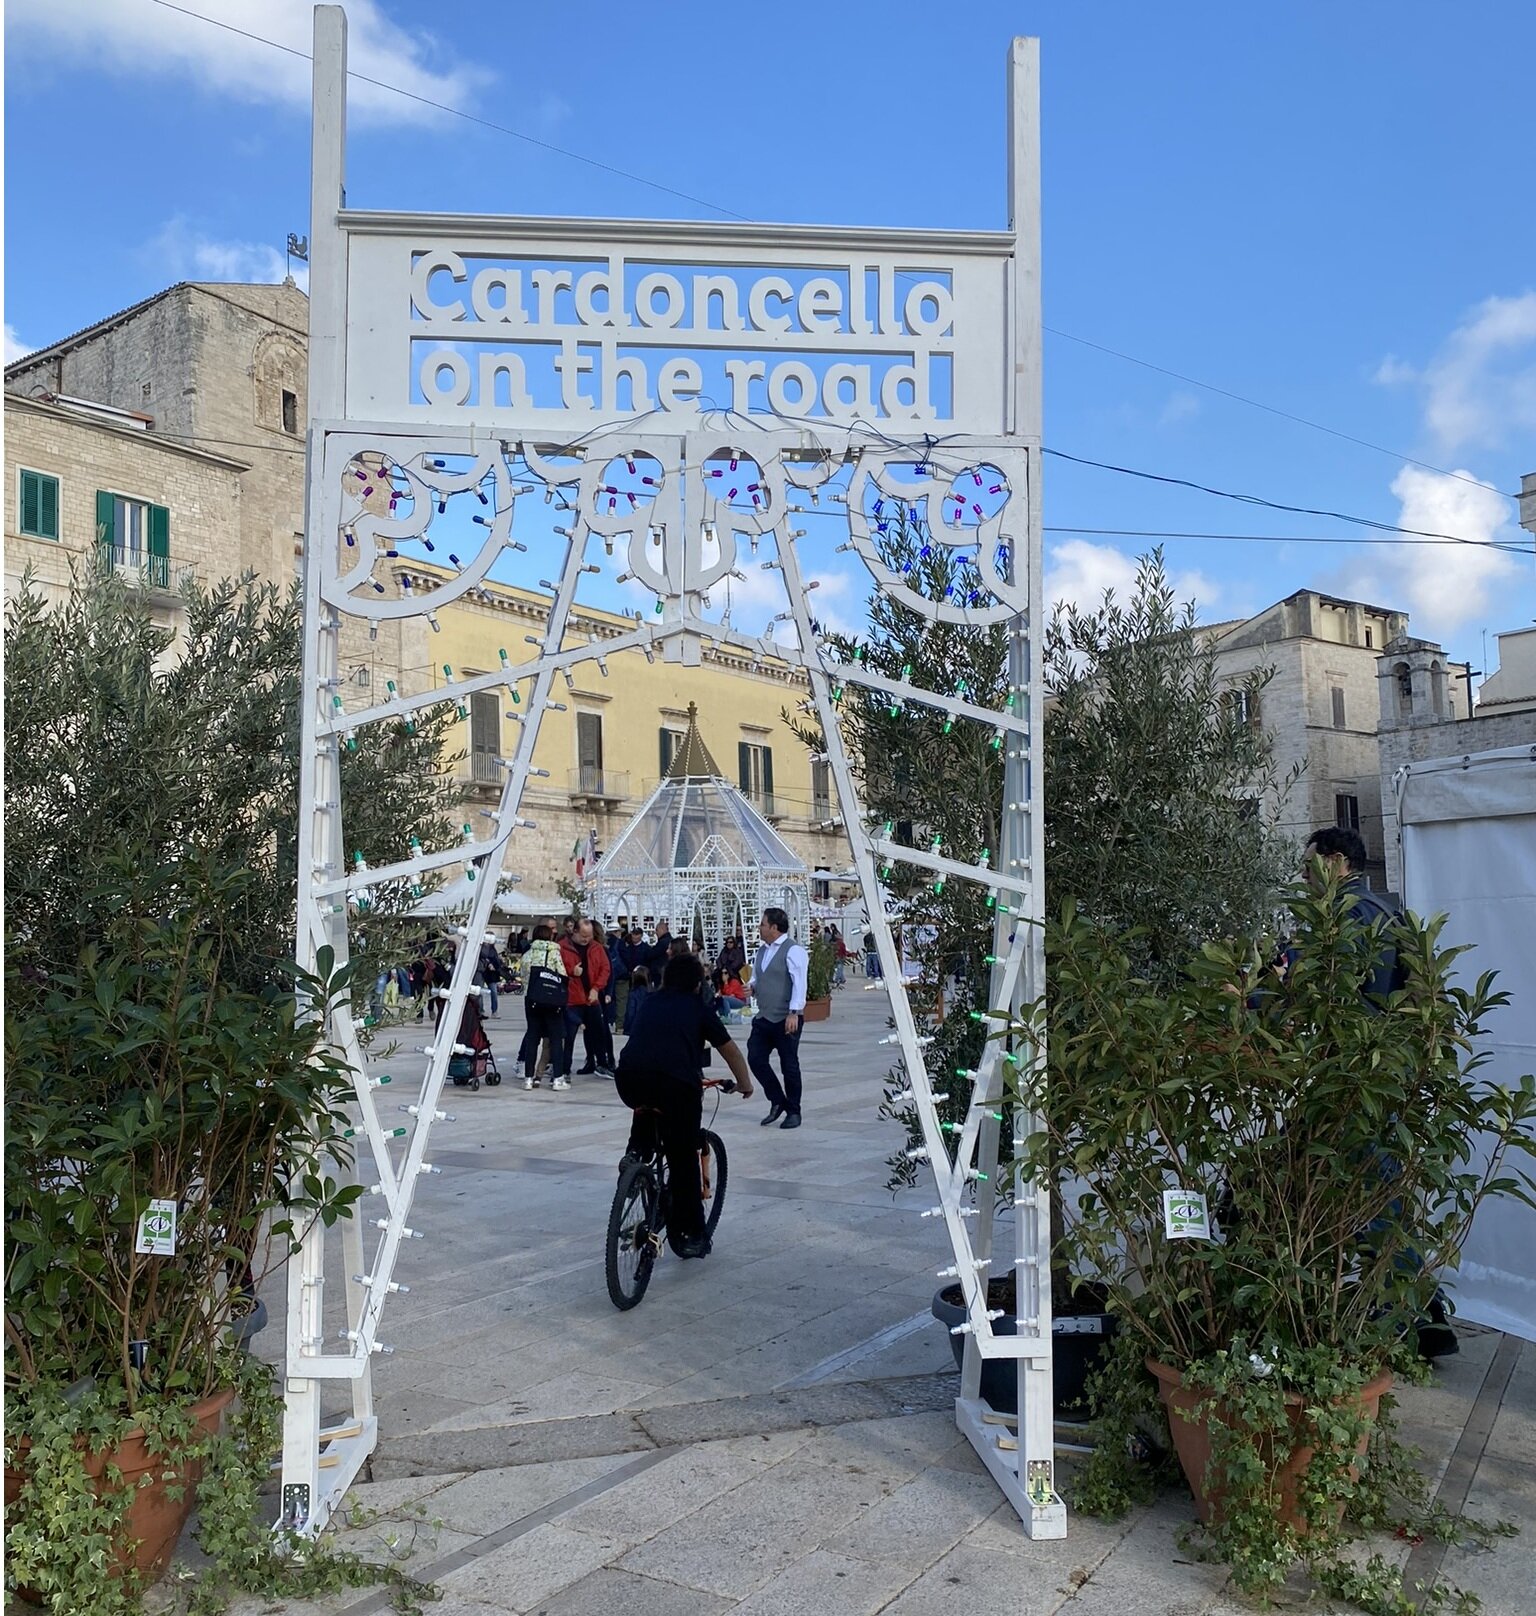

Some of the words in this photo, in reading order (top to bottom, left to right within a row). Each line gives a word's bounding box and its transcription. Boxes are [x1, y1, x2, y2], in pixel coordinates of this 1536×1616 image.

[411, 249, 954, 337] Cardoncello
[420, 350, 532, 407] on
[554, 340, 703, 413] the
[725, 351, 937, 419] road
